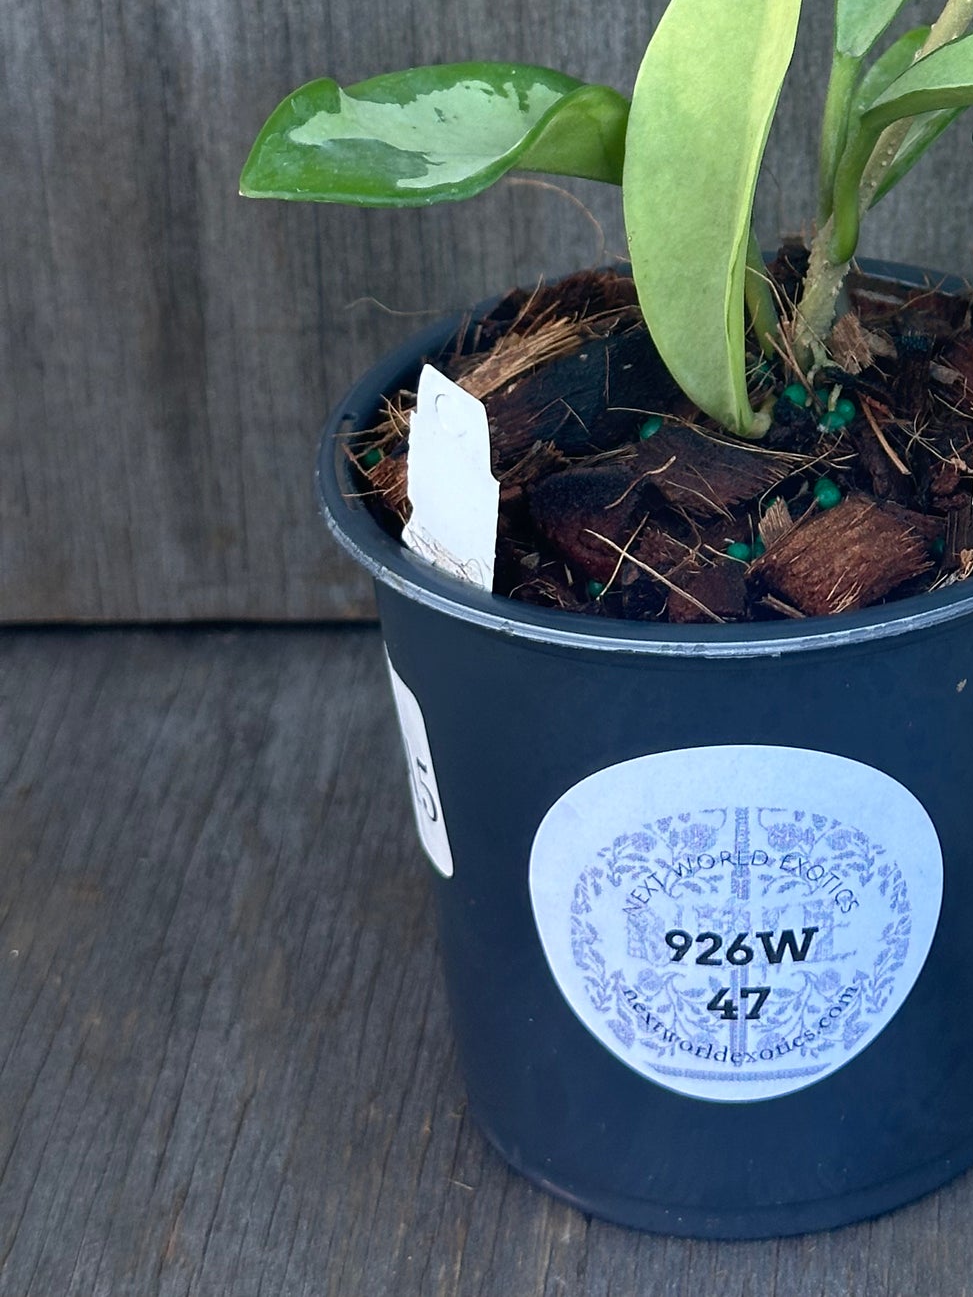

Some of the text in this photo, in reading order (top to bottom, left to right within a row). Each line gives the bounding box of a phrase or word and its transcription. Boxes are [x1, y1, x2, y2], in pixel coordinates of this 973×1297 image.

[622, 850, 860, 916] NEXT WORLD EXOTICS
[664, 927, 819, 966] 926W
[622, 985, 858, 1063] nextworldexotics.com
[706, 986, 771, 1020] 47
